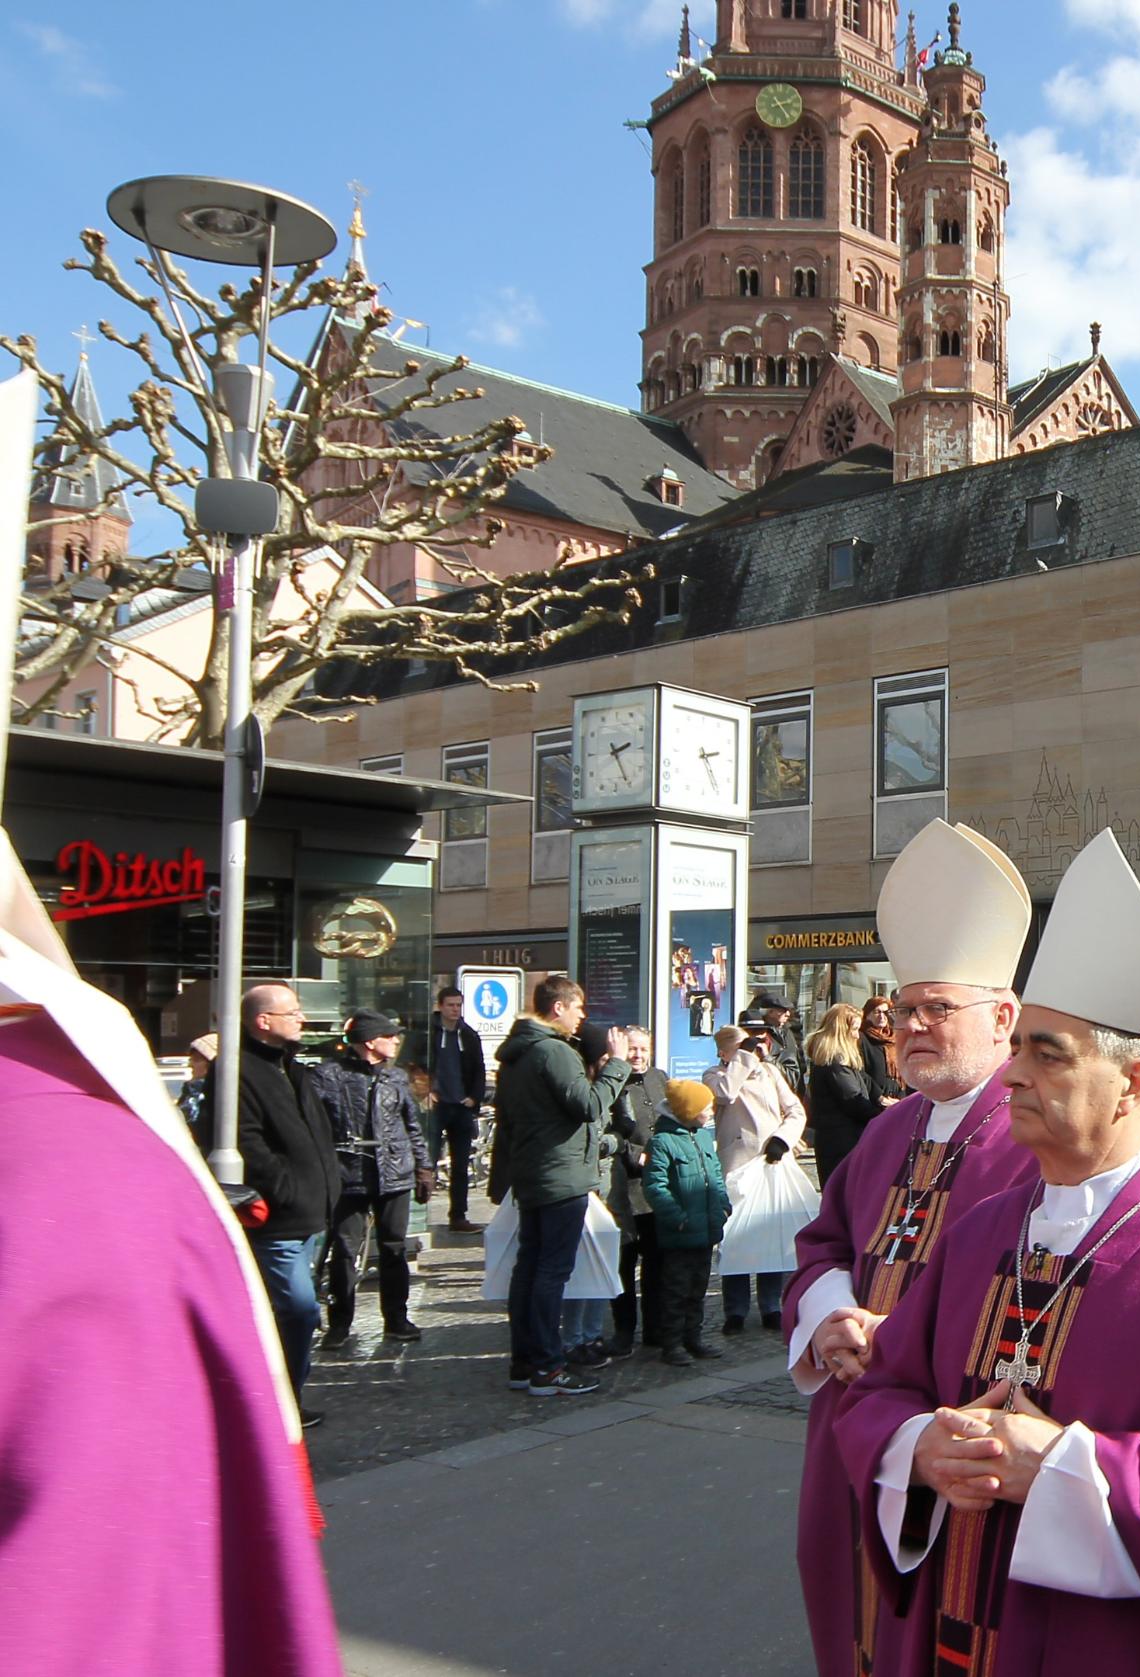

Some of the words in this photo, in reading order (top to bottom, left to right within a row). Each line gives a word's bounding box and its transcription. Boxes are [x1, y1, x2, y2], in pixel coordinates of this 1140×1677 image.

[57, 840, 206, 905] Ditsch
[765, 930, 875, 949] COMMERZBANK
[476, 1022, 504, 1033] ZONE
